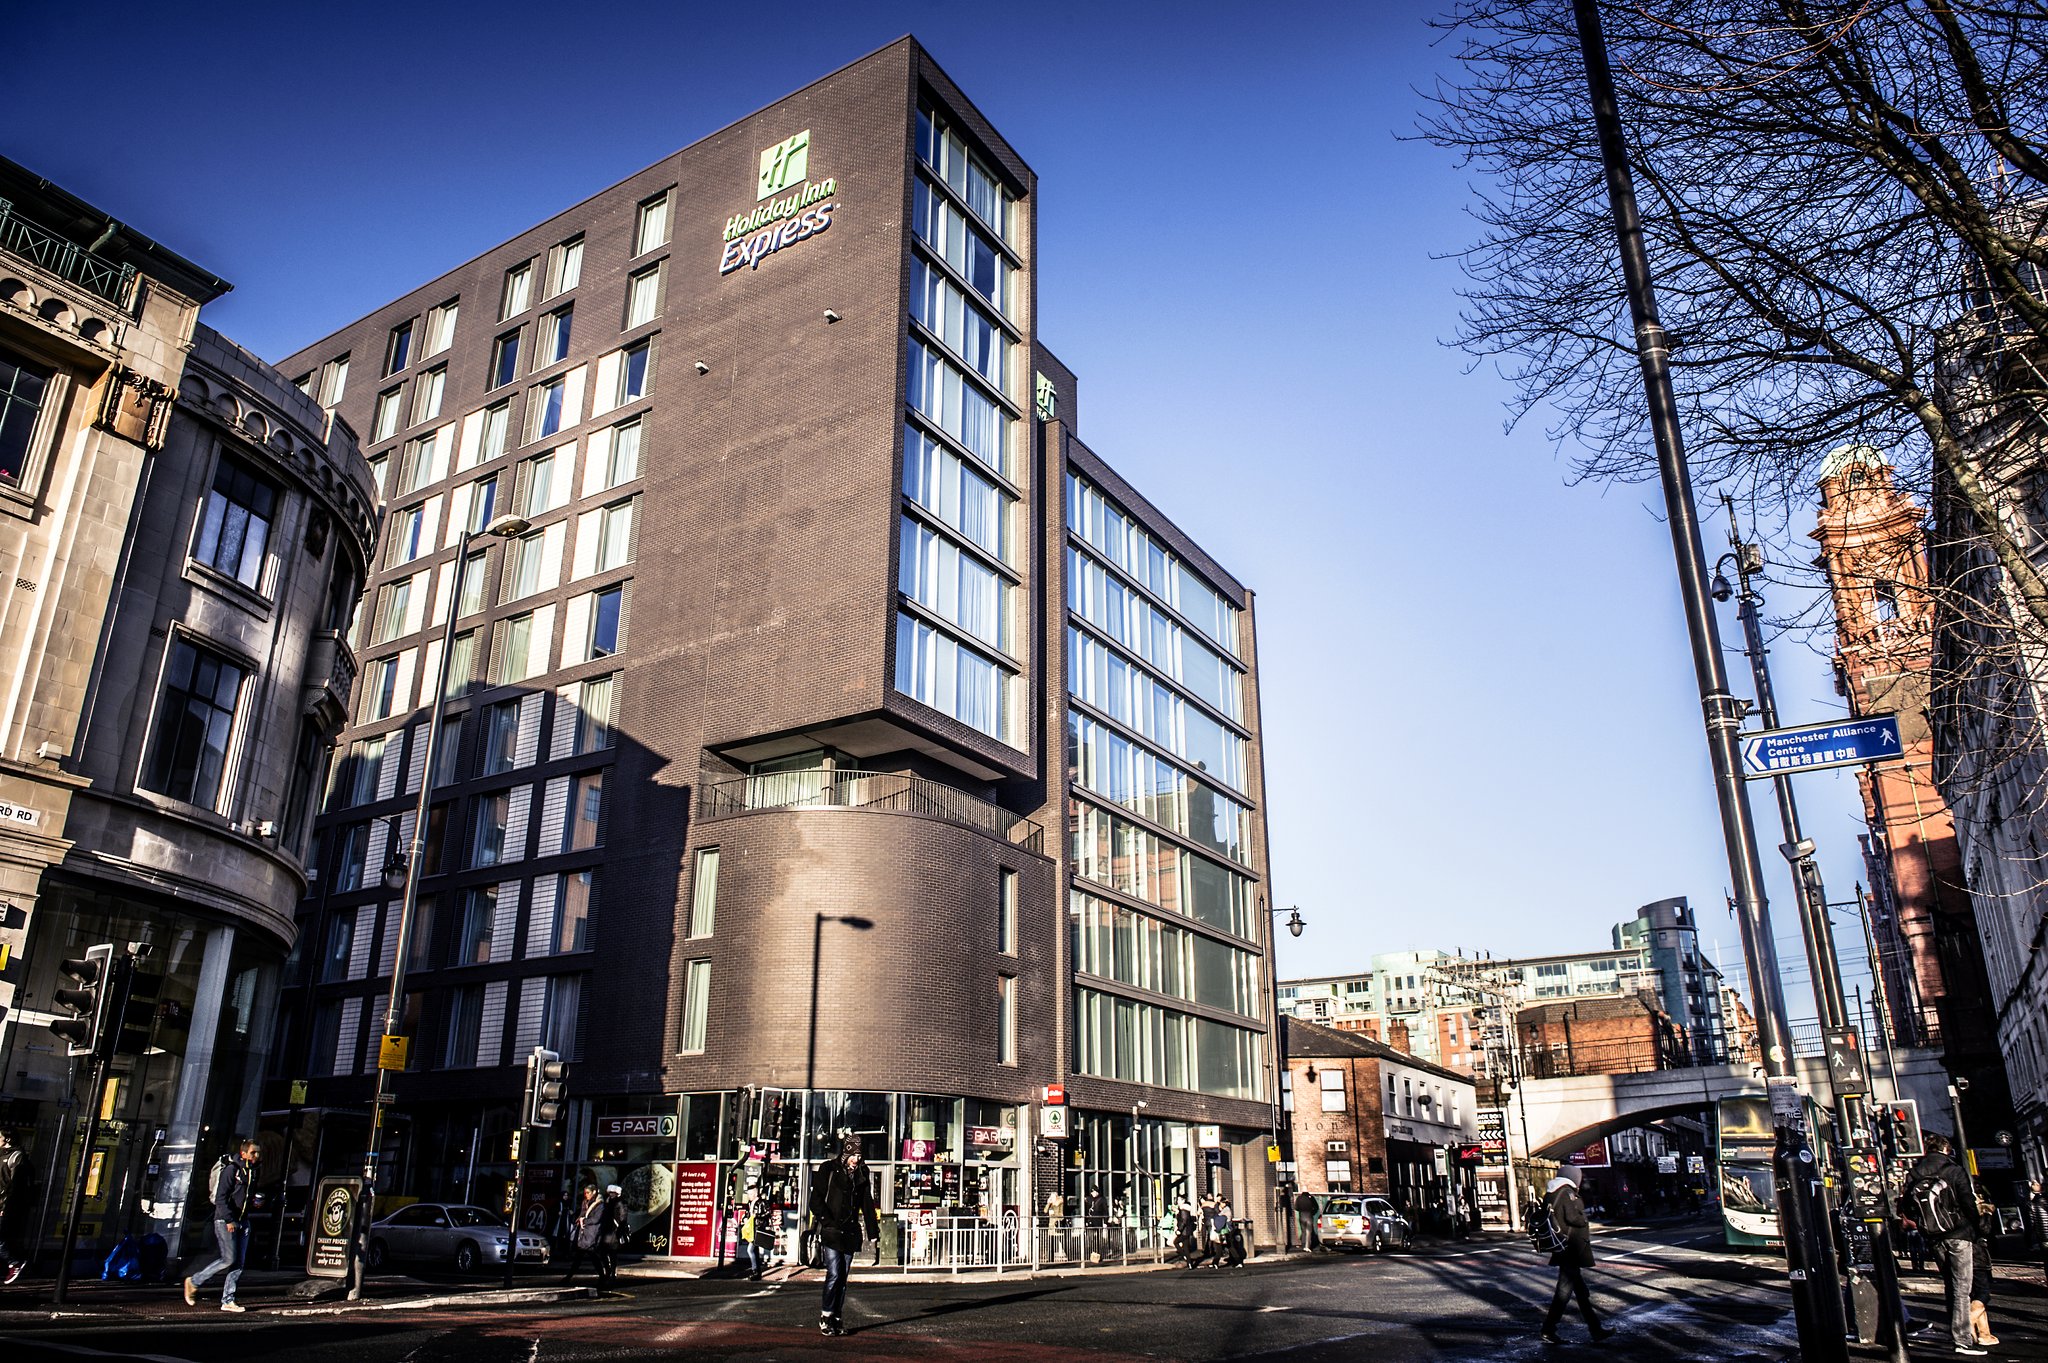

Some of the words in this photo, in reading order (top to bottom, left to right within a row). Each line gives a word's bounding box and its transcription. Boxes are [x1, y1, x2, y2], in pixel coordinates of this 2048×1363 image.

[723, 193, 801, 242] Holiday
[800, 178, 837, 209] Inn
[719, 203, 834, 275] Express
[1766, 732, 1829, 747] Manchester
[1832, 726, 1877, 739] Alliance
[1767, 745, 1805, 757] Centre
[16, 810, 32, 821] RD
[611, 1121, 657, 1133] SPAR
[966, 1130, 998, 1142] SPAR
[527, 1210, 544, 1229] 24
